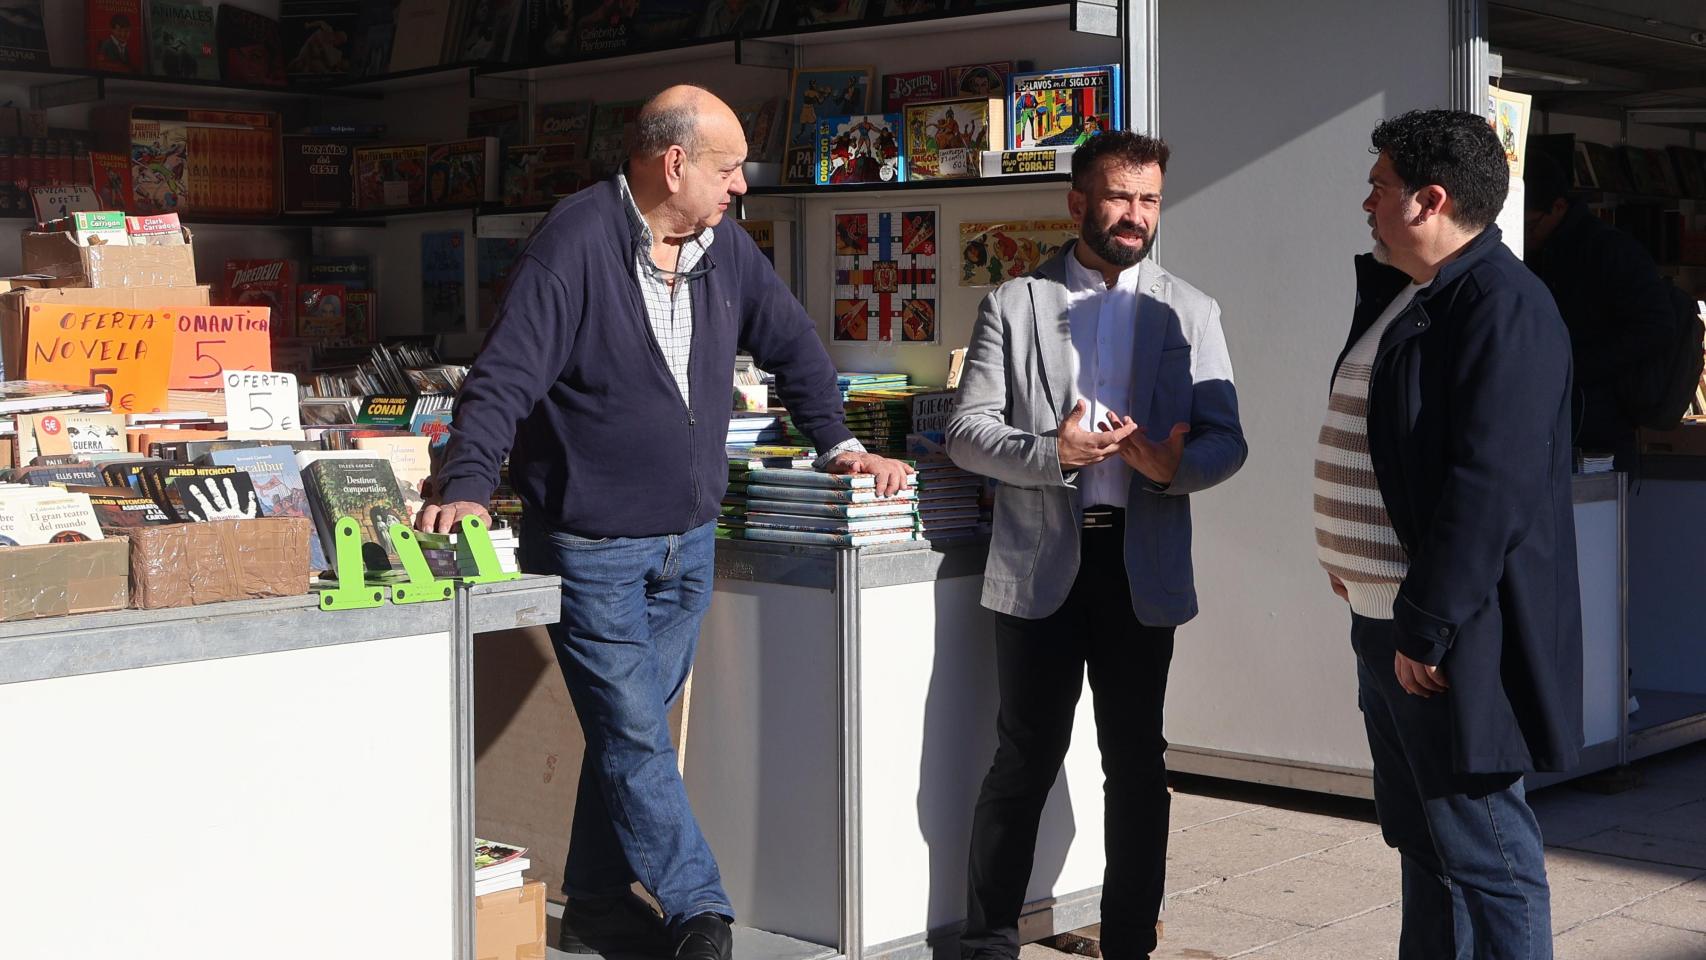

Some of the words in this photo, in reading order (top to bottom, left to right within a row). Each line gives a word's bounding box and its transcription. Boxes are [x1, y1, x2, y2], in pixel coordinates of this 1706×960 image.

[1069, 78, 1089, 87] SIGLO
[820, 138, 829, 182] COLOSO
[1018, 161, 1055, 172] CORAJE
[90, 220, 121, 228] Carrigan
[231, 262, 284, 288] DAREDEVIL
[60, 311, 158, 331] OFERTA
[179, 309, 268, 334] OMANTICA
[34, 336, 148, 364] NOVELA
[188, 339, 227, 380] 5
[227, 373, 289, 388] OFERTA
[89, 367, 118, 409] 5
[119, 393, 137, 412] €
[248, 392, 274, 431] 5
[280, 416, 292, 431] €
[367, 404, 406, 415] CONAN
[915, 397, 954, 416] JUEGOS
[44, 419, 58, 432] 5€
[73, 440, 103, 450] GUERRA
[168, 467, 196, 476] ALFRED
[196, 467, 236, 475] HITCHCOCK
[237, 461, 284, 473] xcalibur
[55, 472, 72, 480] ELLIS
[73, 471, 96, 480] PETERS
[346, 475, 377, 485] Destinos
[343, 484, 387, 495] compartidos
[30, 512, 40, 522] El
[41, 513, 61, 523] gran
[63, 510, 89, 519] teatro
[39, 523, 53, 531] del
[54, 519, 87, 529] mundo
